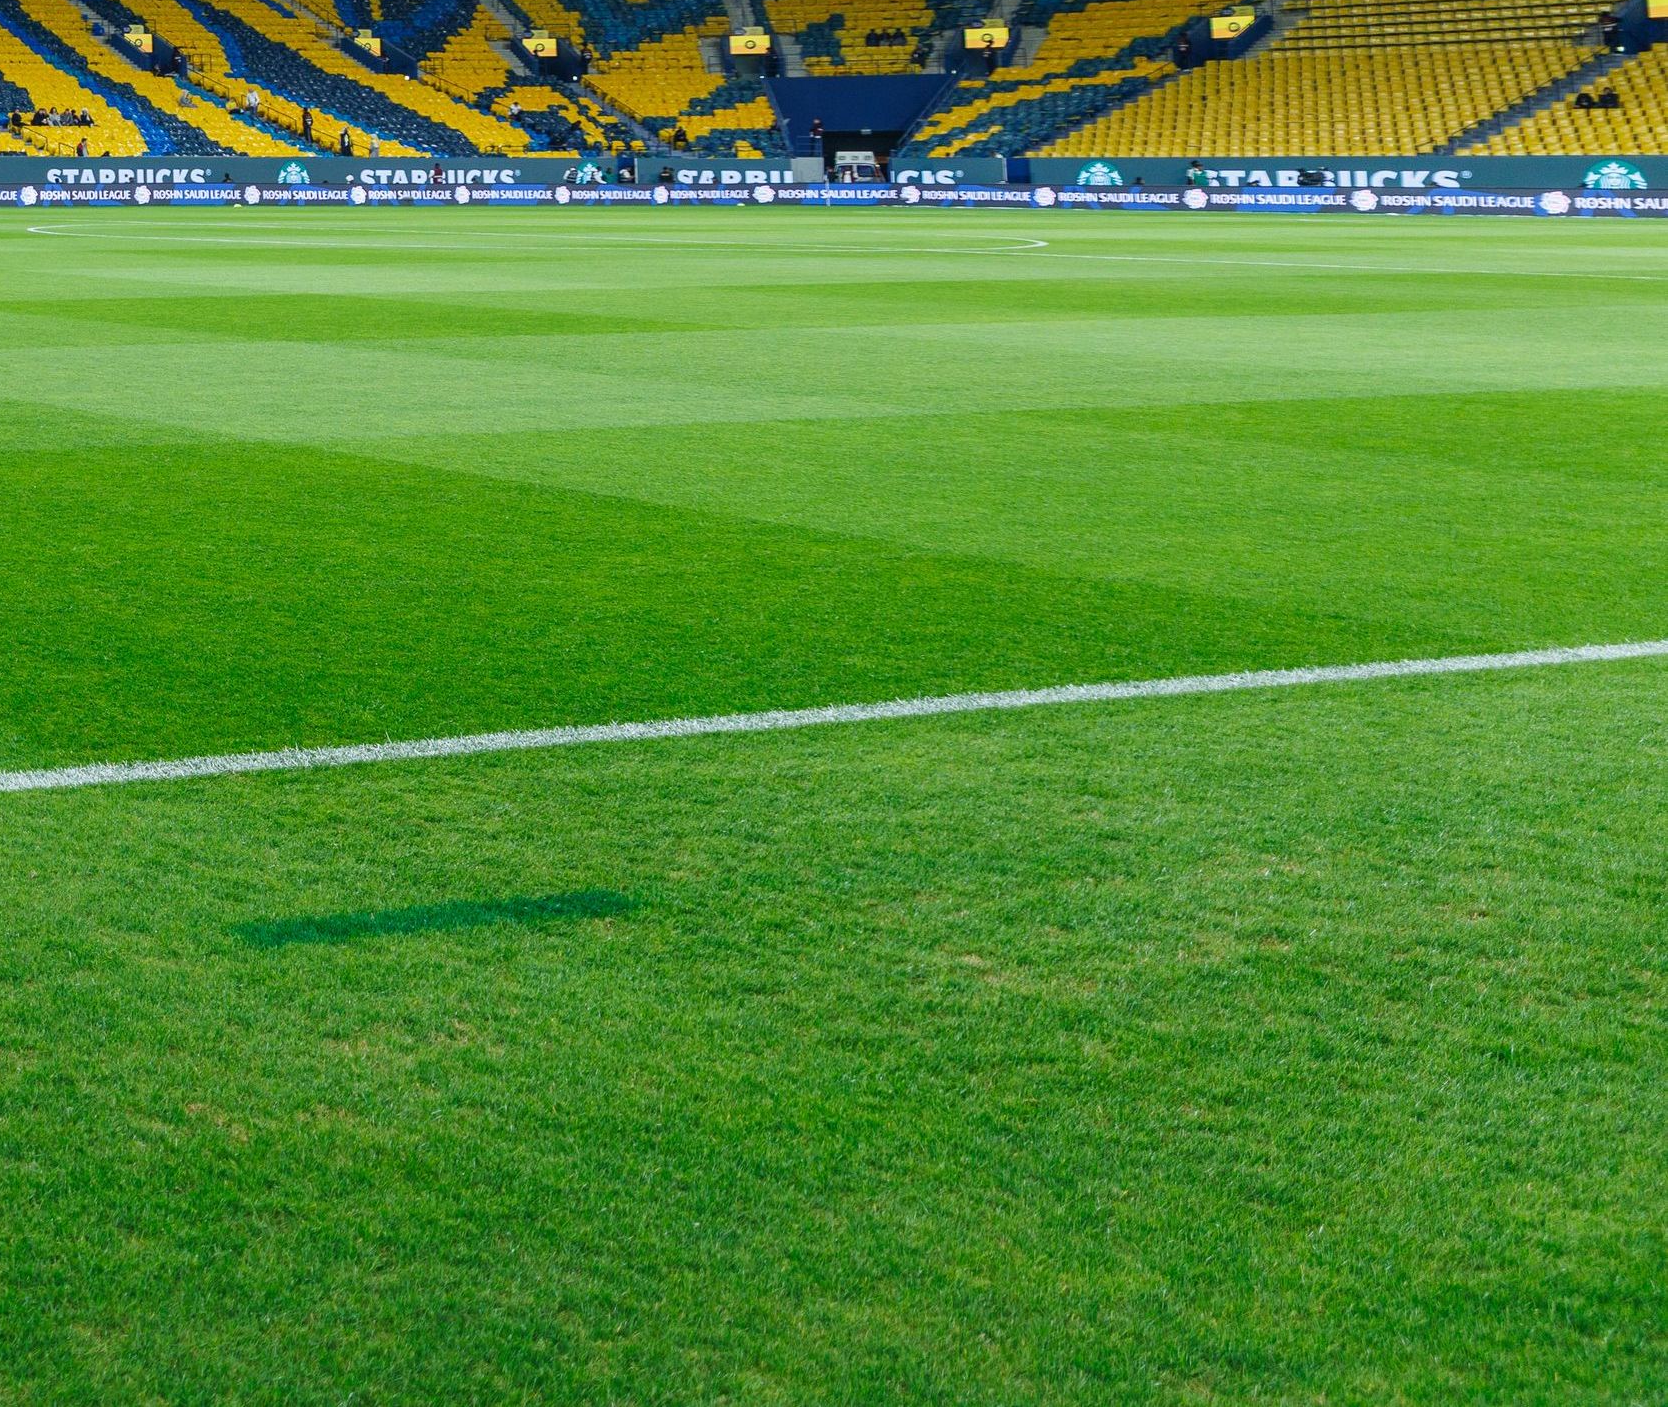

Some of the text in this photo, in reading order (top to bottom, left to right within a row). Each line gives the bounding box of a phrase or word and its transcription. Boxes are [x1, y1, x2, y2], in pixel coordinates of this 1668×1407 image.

[40, 191, 130, 200] ROSHN SAUDI LEAGUE
[154, 190, 241, 199] ROSHN SAUDI LEAGUE
[263, 191, 348, 199] ROSHN SAUDI LEAGUE
[1574, 197, 1631, 209] ROSHN
